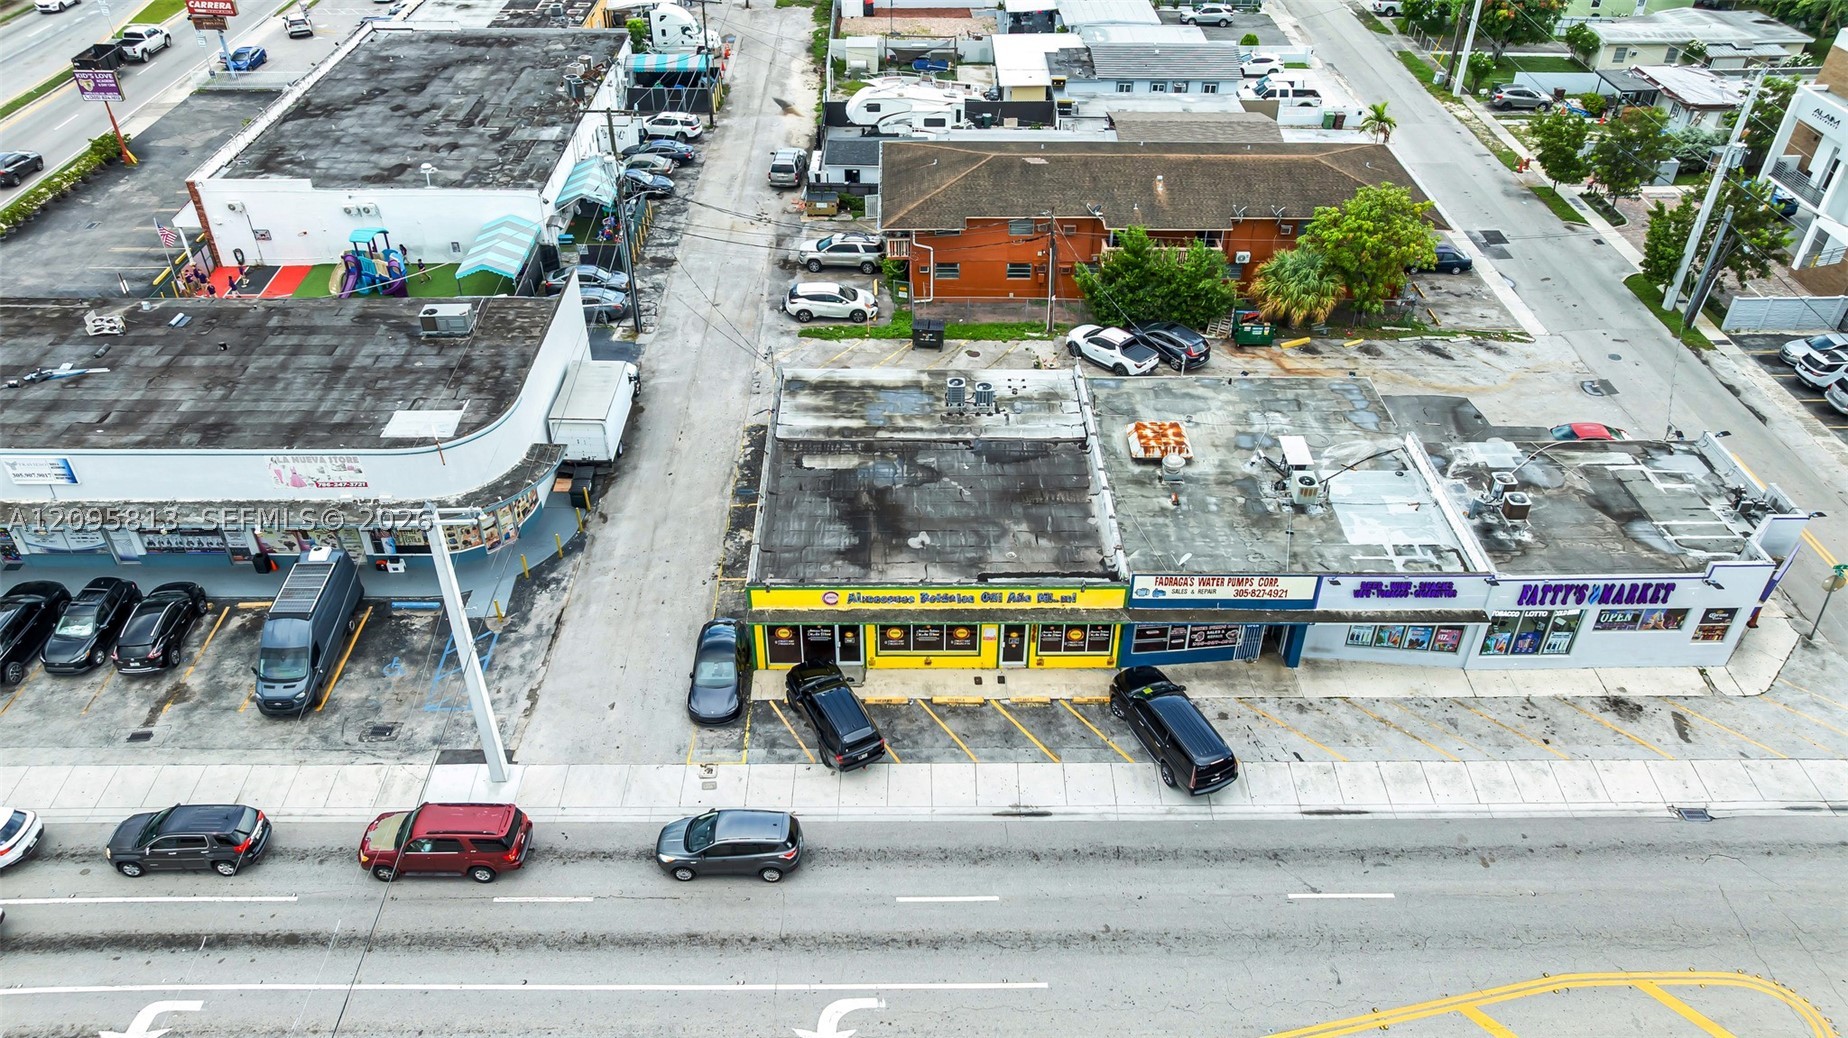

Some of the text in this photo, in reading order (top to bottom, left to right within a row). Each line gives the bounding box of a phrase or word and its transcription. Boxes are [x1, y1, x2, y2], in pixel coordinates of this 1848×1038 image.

[188, 1, 232, 10] CARRERA
[1154, 577, 1280, 588] FADRAGA'S WATER PUMPS CORP.
[1360, 581, 1454, 590] BEER WINE SNACKS
[1517, 583, 1676, 606] FATTY'S MARKET
[1600, 612, 1634, 623] OPEN
